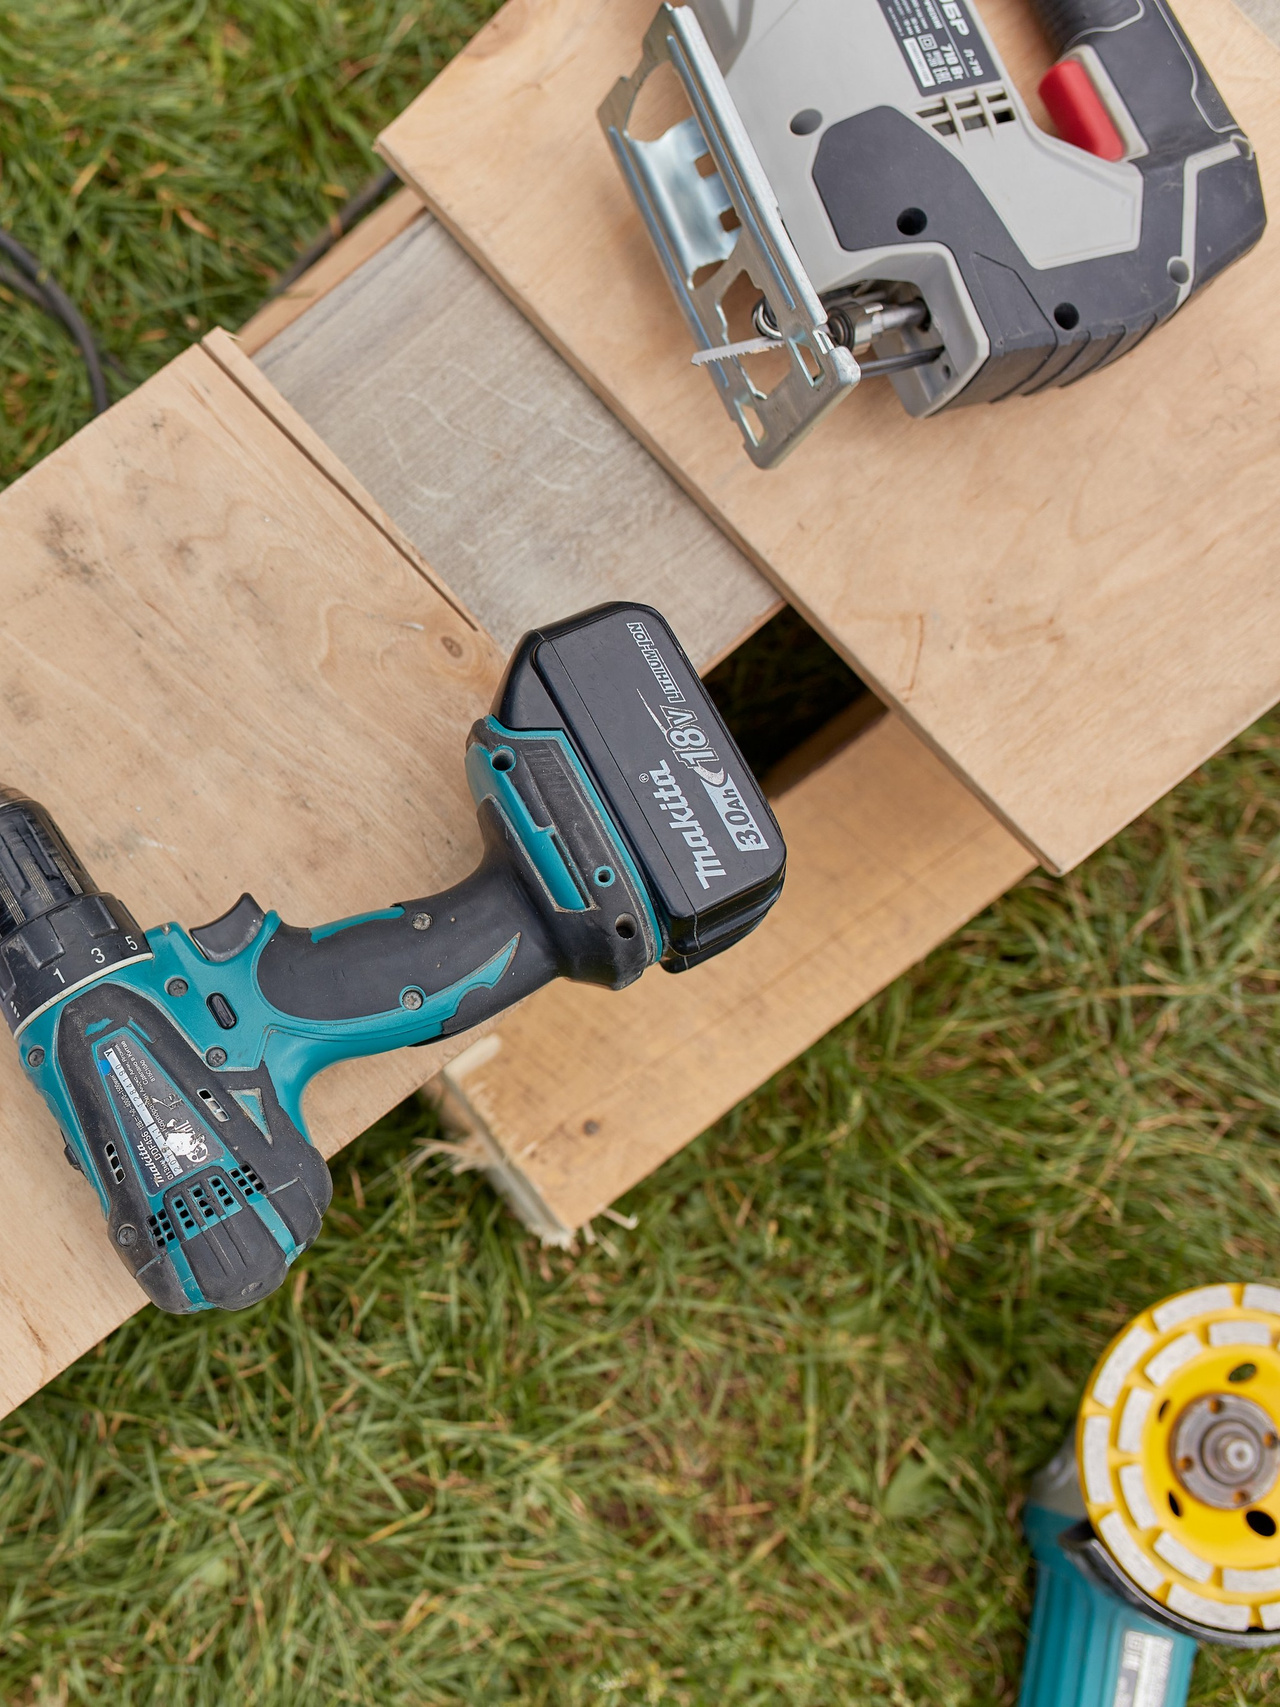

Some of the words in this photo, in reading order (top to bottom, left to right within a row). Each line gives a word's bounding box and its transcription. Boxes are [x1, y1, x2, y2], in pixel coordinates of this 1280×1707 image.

[626, 622, 687, 704] LITHIUM-ION
[660, 705, 720, 770] 18V
[651, 760, 726, 890] makita
[721, 786, 762, 849] 3.0Ah
[53, 968, 66, 984] 1
[91, 948, 106, 964] 3
[125, 936, 138, 952] 5
[136, 1140, 164, 1187] makita
[141, 1131, 161, 1161] DDF456
